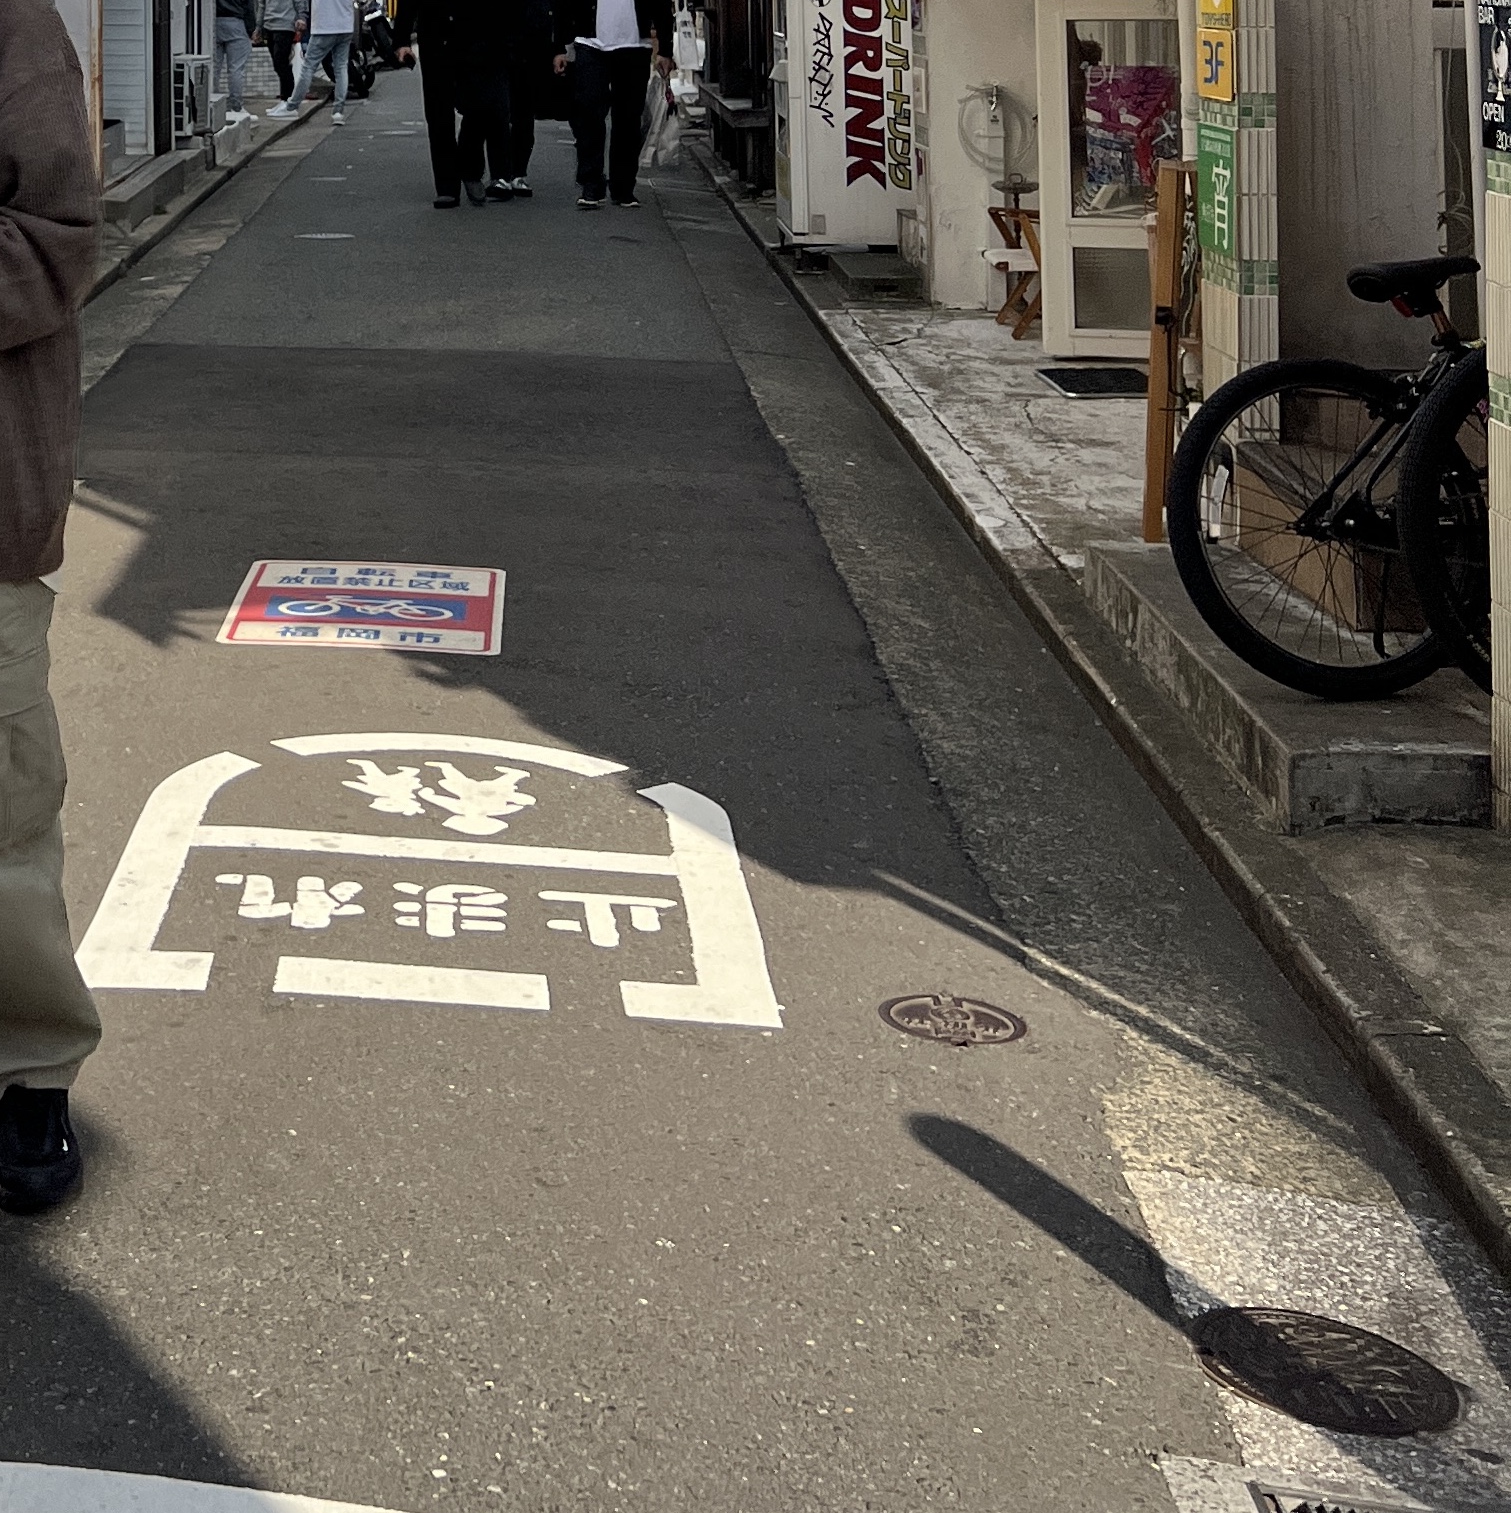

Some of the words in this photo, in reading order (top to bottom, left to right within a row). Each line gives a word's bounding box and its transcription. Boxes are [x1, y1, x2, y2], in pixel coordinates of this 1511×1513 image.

[1478, 5, 1495, 24] BAR
[1482, 101, 1505, 123] OPEN
[276, 624, 444, 644] 福岡市
[214, 872, 678, 948] 止まれ
